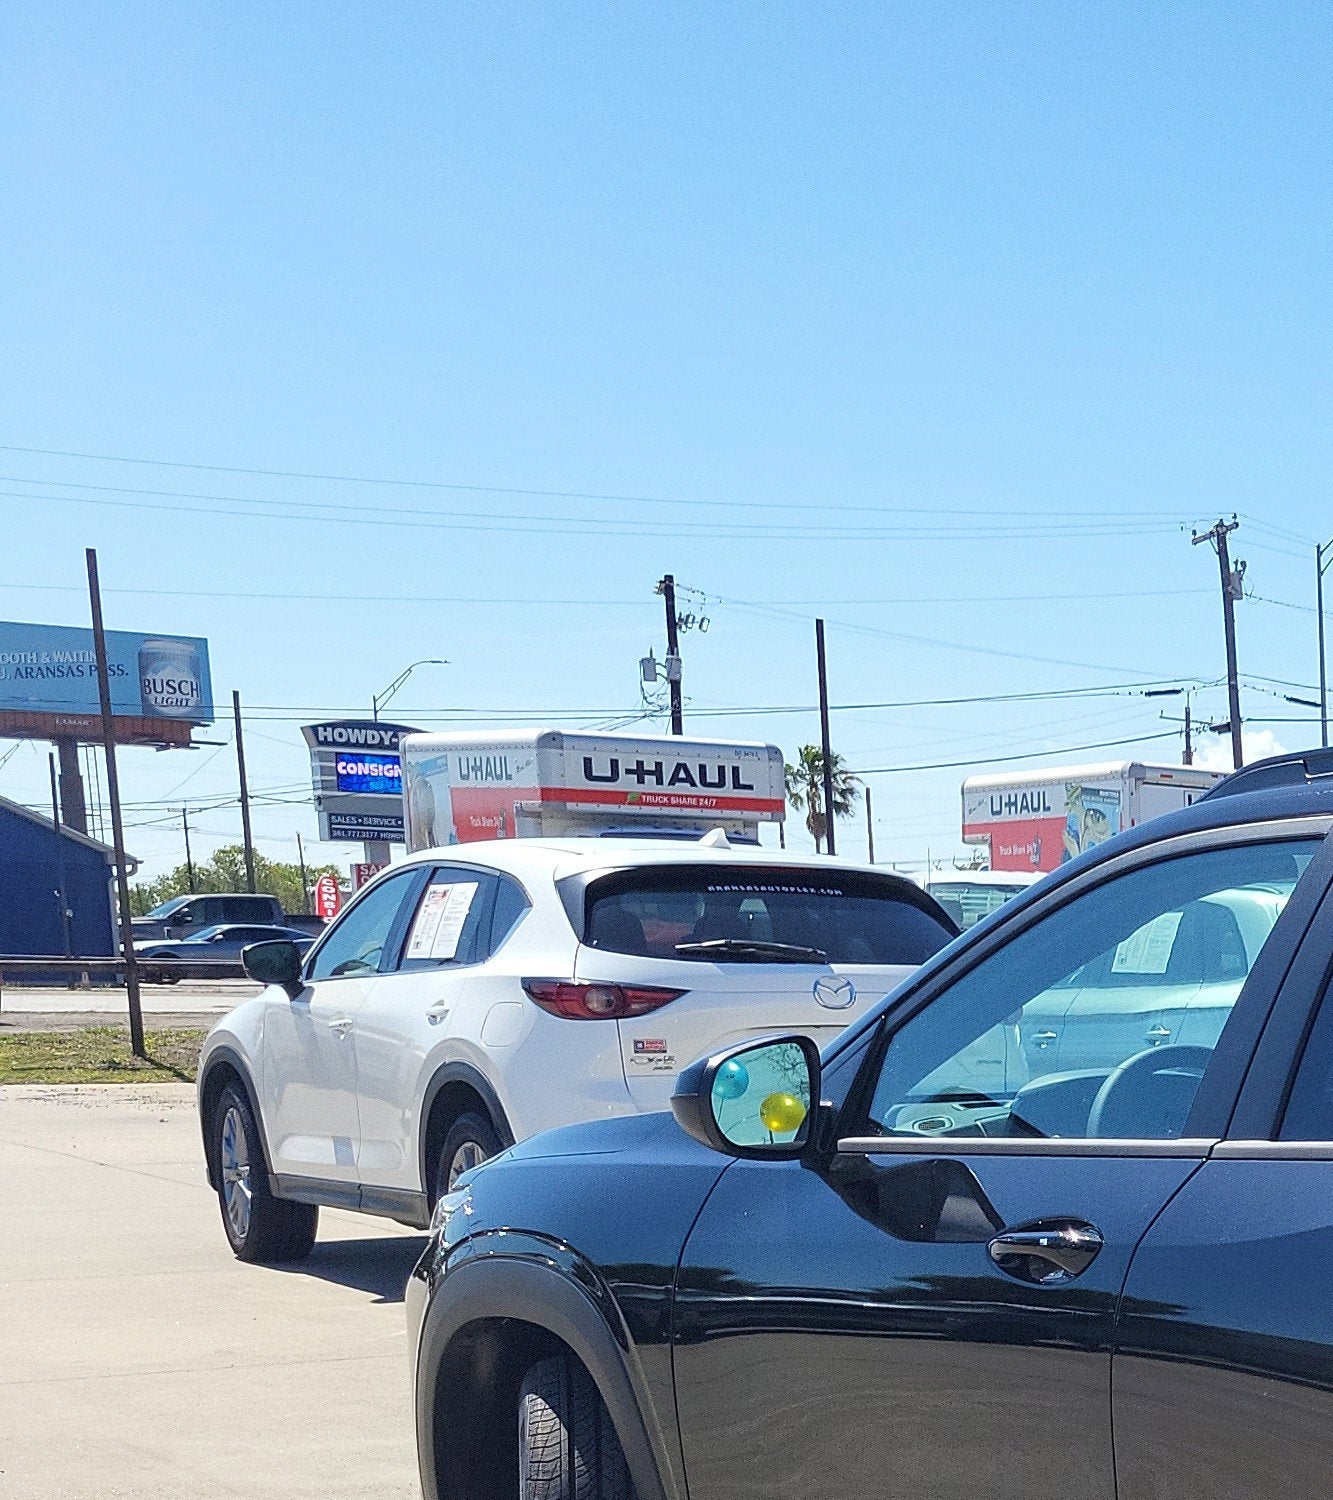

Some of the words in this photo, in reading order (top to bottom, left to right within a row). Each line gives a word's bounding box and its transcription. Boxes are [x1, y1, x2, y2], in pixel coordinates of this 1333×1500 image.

[15, 664, 84, 679] ARANSAS
[89, 663, 129, 677] PSS.
[143, 678, 199, 698] BUSCH
[153, 696, 193, 707] LIGHT
[583, 757, 754, 791] U-HAUL
[642, 794, 669, 804] TRUCK
[670, 796, 698, 806] SHARE
